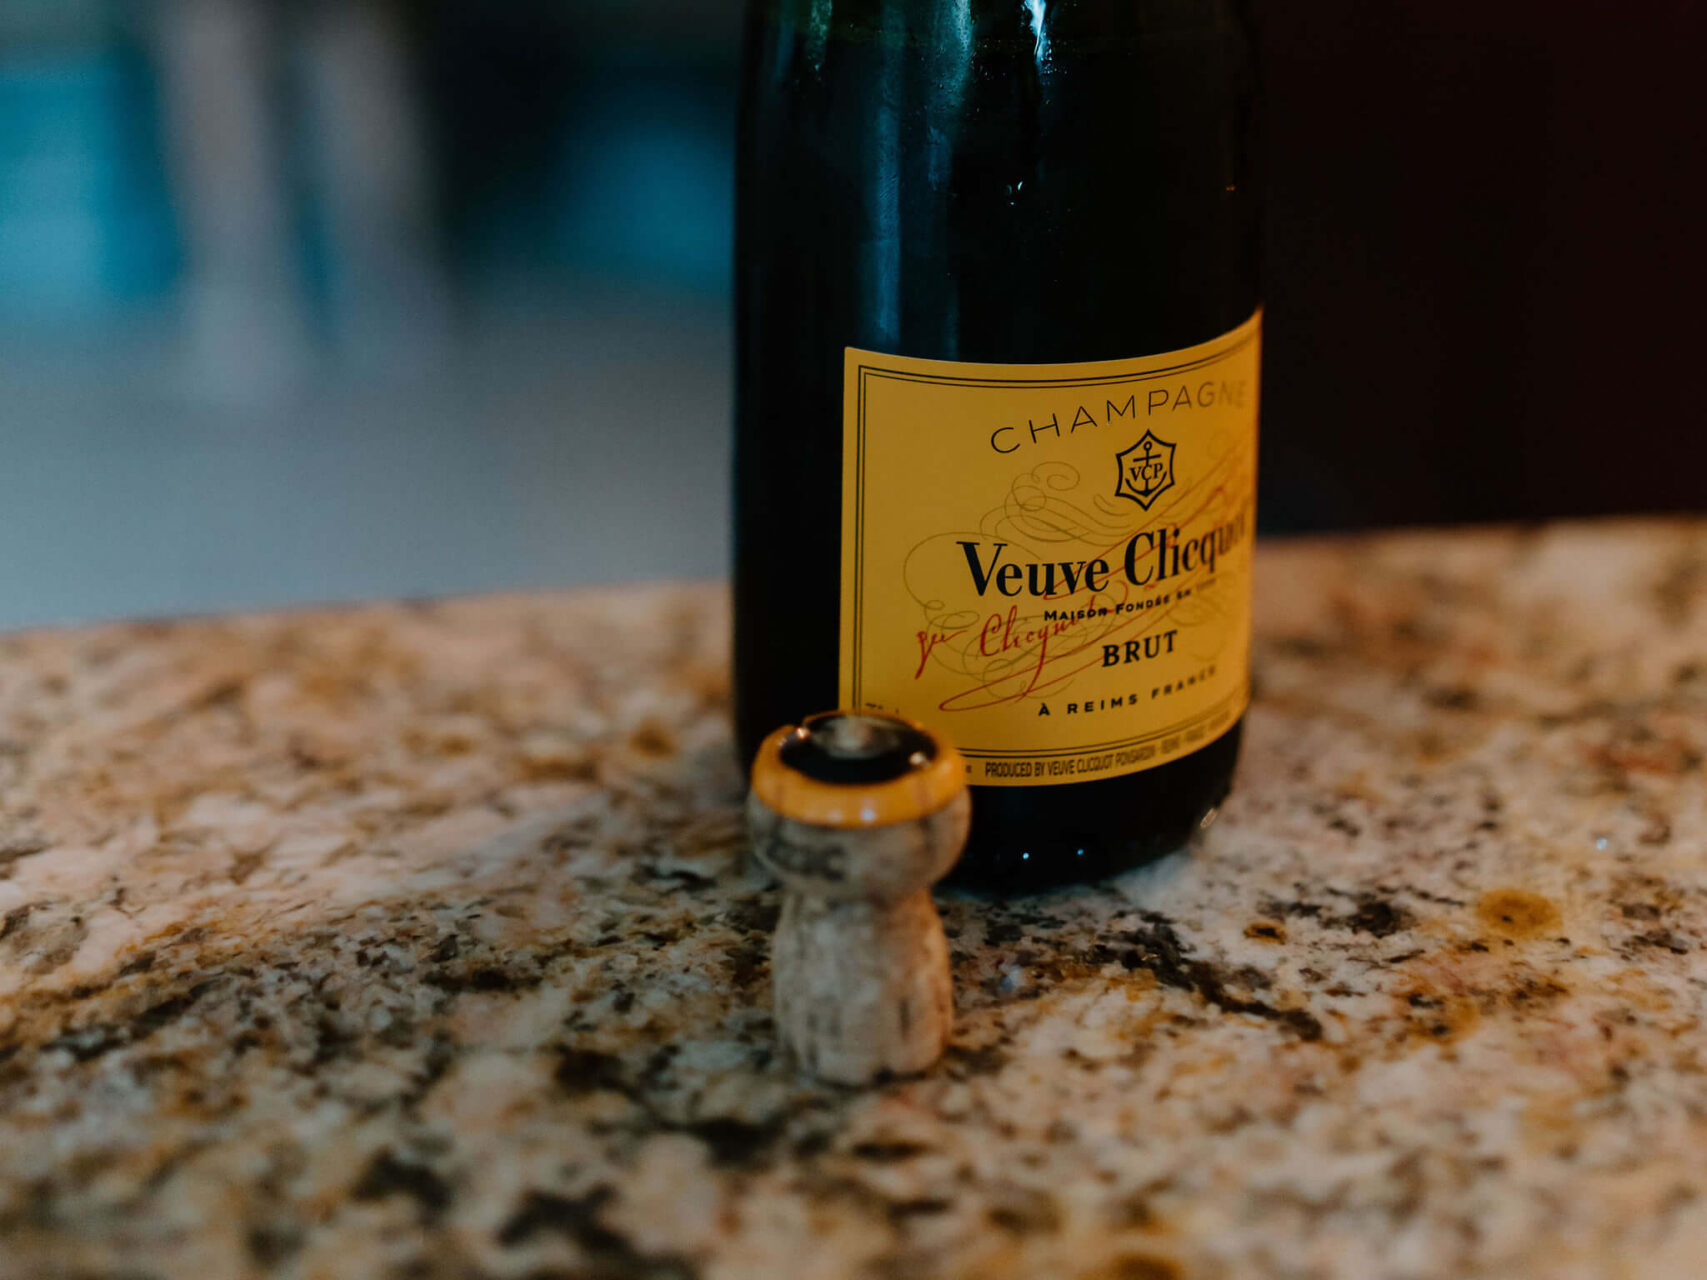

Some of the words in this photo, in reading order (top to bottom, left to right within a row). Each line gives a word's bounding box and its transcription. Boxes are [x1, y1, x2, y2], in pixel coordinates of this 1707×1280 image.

[1130, 462, 1163, 482] VCP
[955, 541, 1110, 597] Veuve
[1101, 629, 1178, 668] BRUT
[1038, 702, 1051, 717] À
[1067, 693, 1138, 715] REIMS
[984, 760, 1032, 778] PRODUCED
[1034, 760, 1046, 777] BY
[1047, 758, 1075, 776] VEUVE
